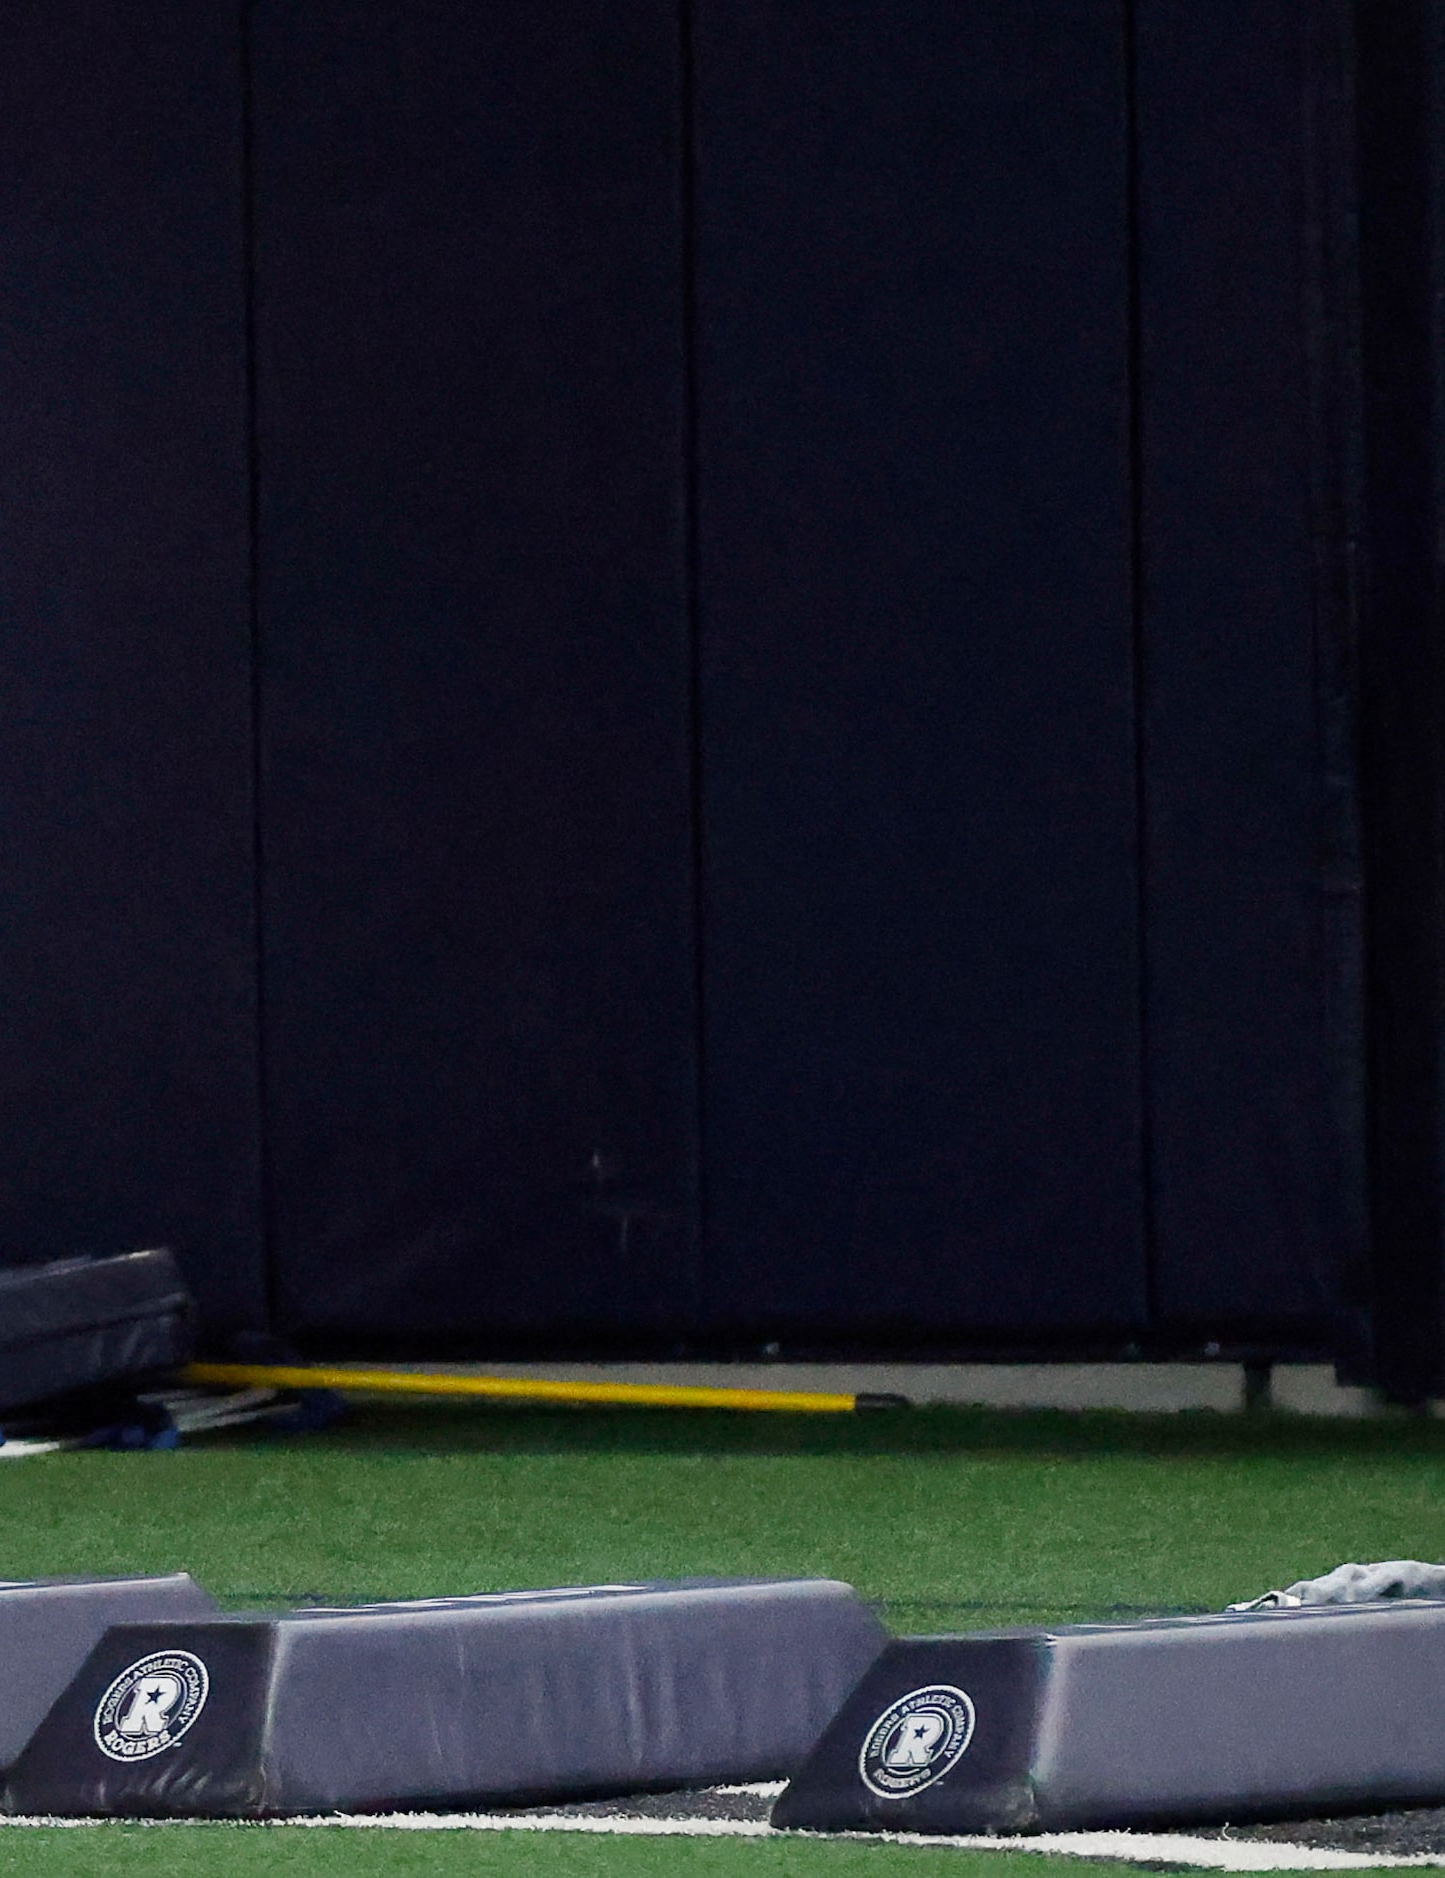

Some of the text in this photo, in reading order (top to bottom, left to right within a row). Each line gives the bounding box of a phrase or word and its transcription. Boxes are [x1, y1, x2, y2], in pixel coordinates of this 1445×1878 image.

[119, 1675, 182, 1735] R
[104, 1729, 171, 1755] ROGERS
[886, 1713, 944, 1767] R
